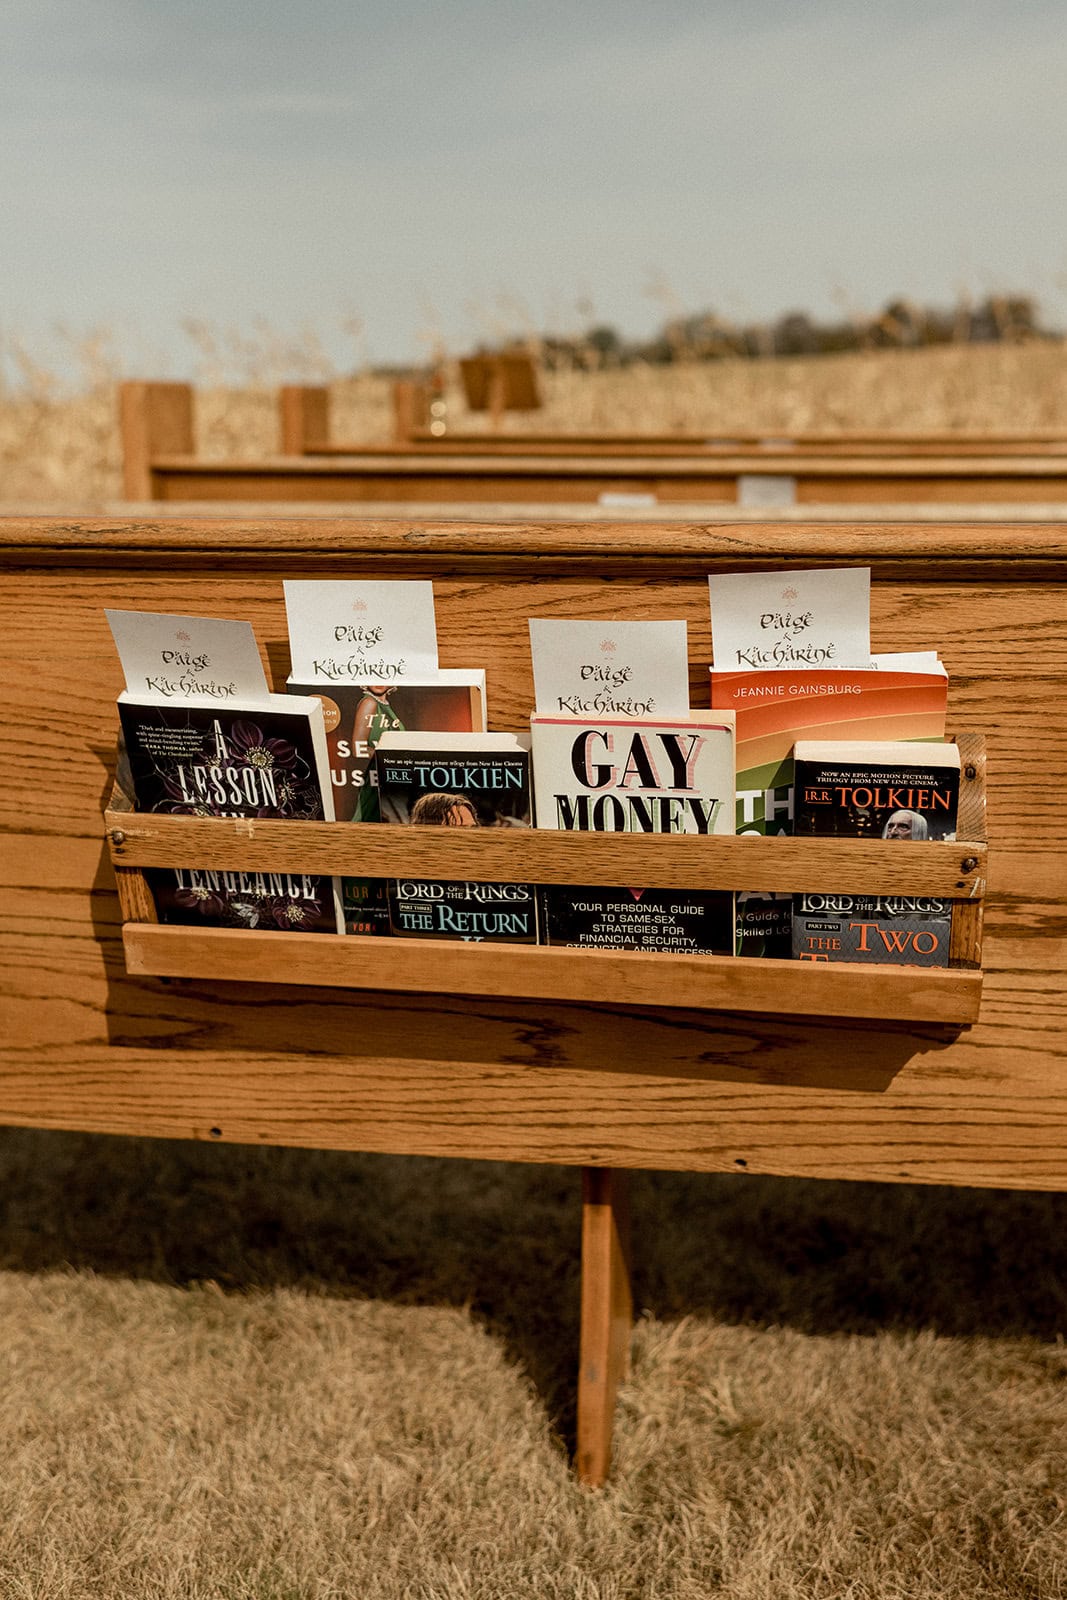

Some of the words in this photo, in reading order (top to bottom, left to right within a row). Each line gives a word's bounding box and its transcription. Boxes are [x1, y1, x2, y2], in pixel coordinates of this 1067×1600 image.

[733, 686, 784, 698] JEANNIE
[788, 685, 862, 695] GAINSBURG
[364, 713, 400, 728] The
[214, 719, 230, 760] A
[571, 730, 703, 790] GAY
[177, 764, 278, 807] LESSON
[386, 770, 412, 782] J.R.R.
[414, 766, 524, 789] TOLKIEN
[736, 789, 794, 824] TH
[804, 790, 832, 802] J.R.R.
[834, 786, 952, 810] TOLKIEN
[553, 794, 720, 834] MONEY
[396, 879, 444, 900] LORD
[446, 892, 464, 900] THE
[464, 882, 529, 903] RINGS
[572, 902, 602, 912] YOUR
[606, 904, 666, 914] PERSONAL
[670, 905, 704, 916] GUIDE
[800, 893, 853, 913] LORD
[855, 902, 874, 911] THE
[874, 896, 944, 914] RINGS
[400, 913, 434, 930] THE
[436, 905, 528, 934] RETURN
[601, 914, 615, 923] TO
[619, 914, 676, 924] SAME-SEX
[746, 912, 780, 922] Guide
[580, 934, 638, 944] FINANCIAL
[642, 936, 698, 948] SECURITY,
[592, 924, 658, 934] STRATEGIES
[662, 926, 684, 936] FOR
[736, 928, 773, 938] Skilled
[806, 936, 841, 950] THE
[850, 923, 938, 954] TWO
